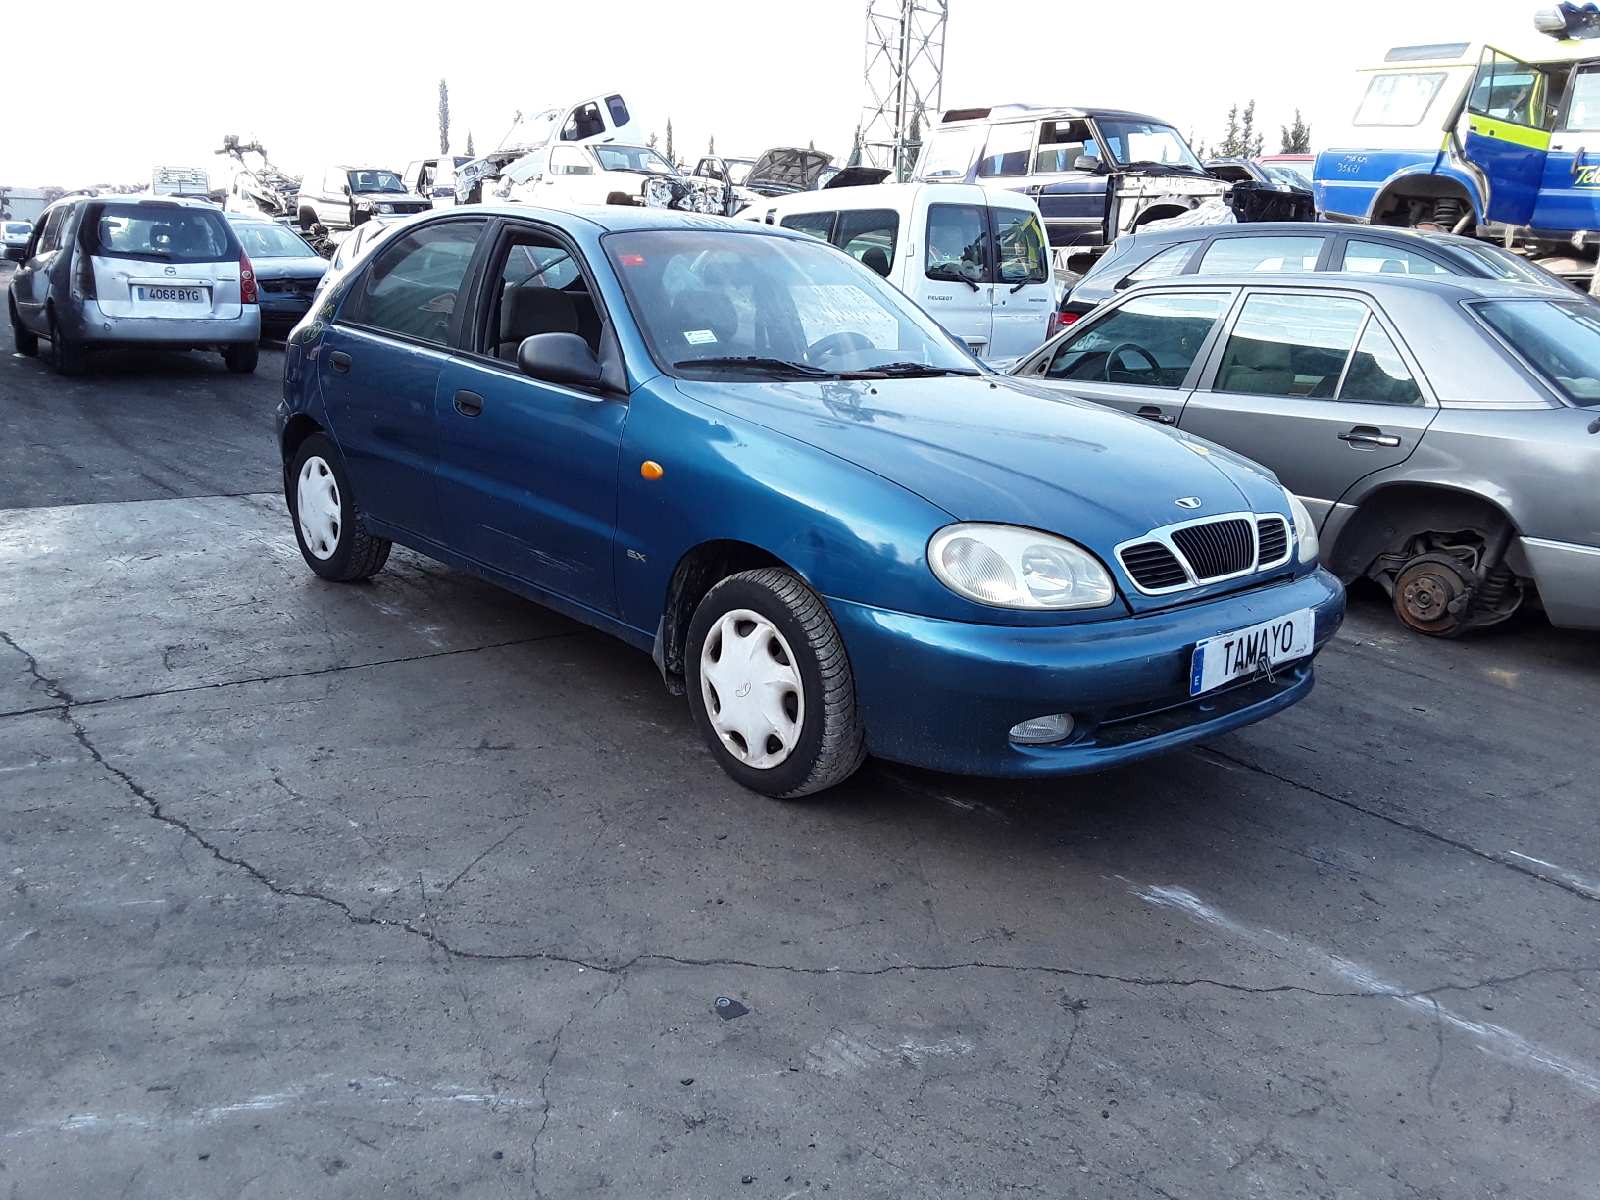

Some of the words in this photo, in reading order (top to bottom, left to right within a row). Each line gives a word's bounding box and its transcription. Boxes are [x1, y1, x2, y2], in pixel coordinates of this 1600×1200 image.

[149, 288, 176, 301] 4068
[178, 289, 199, 302] BYG
[1224, 620, 1294, 676] TAMAYO
[1194, 675, 1200, 686] E
